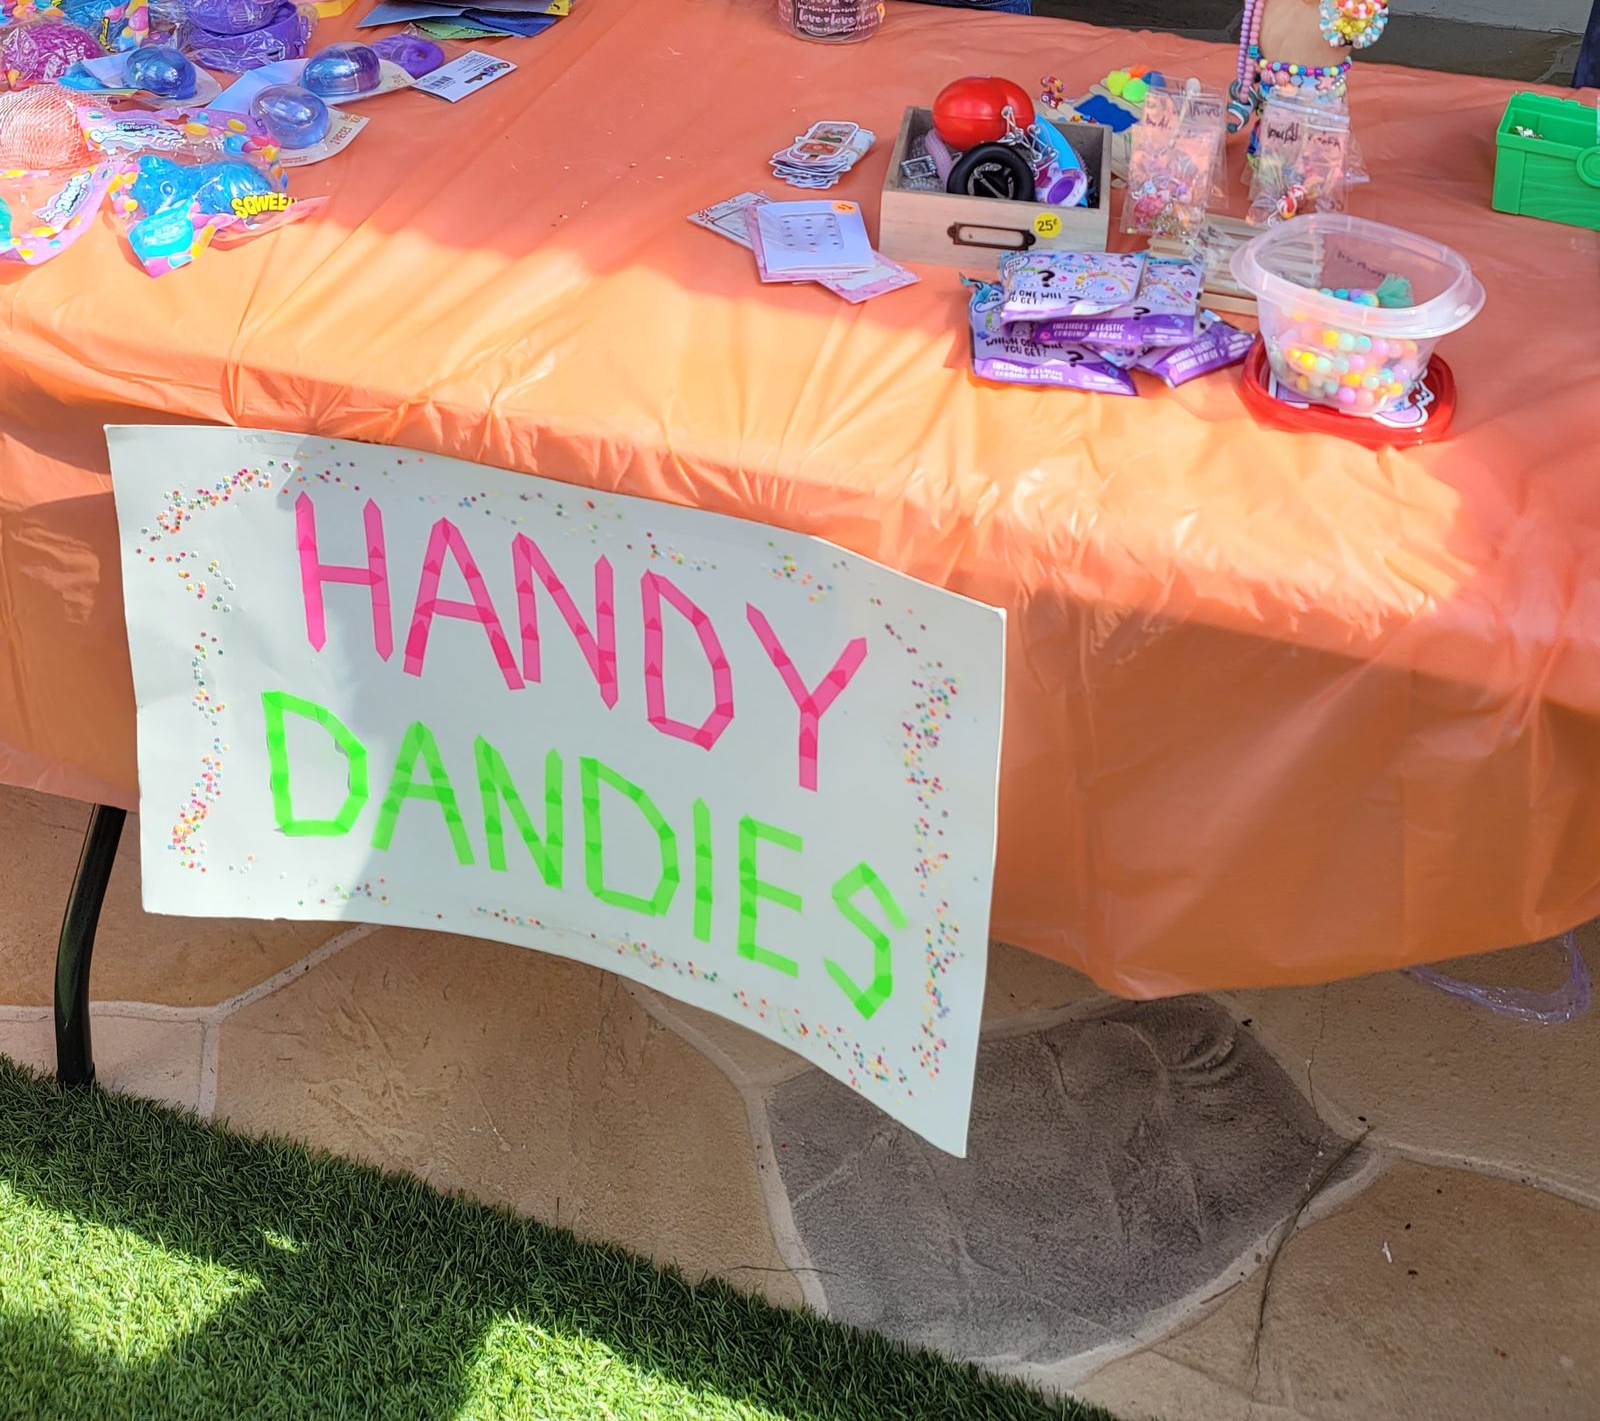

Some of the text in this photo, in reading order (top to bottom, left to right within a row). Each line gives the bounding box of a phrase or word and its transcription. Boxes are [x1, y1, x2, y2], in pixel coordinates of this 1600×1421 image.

[799, 8, 822, 24] love
[830, 12, 857, 26] love
[1019, 290, 1036, 298] ONE
[1041, 290, 1061, 300] WILL
[295, 491, 867, 792] HANDY
[261, 691, 908, 1020] DANDIES
